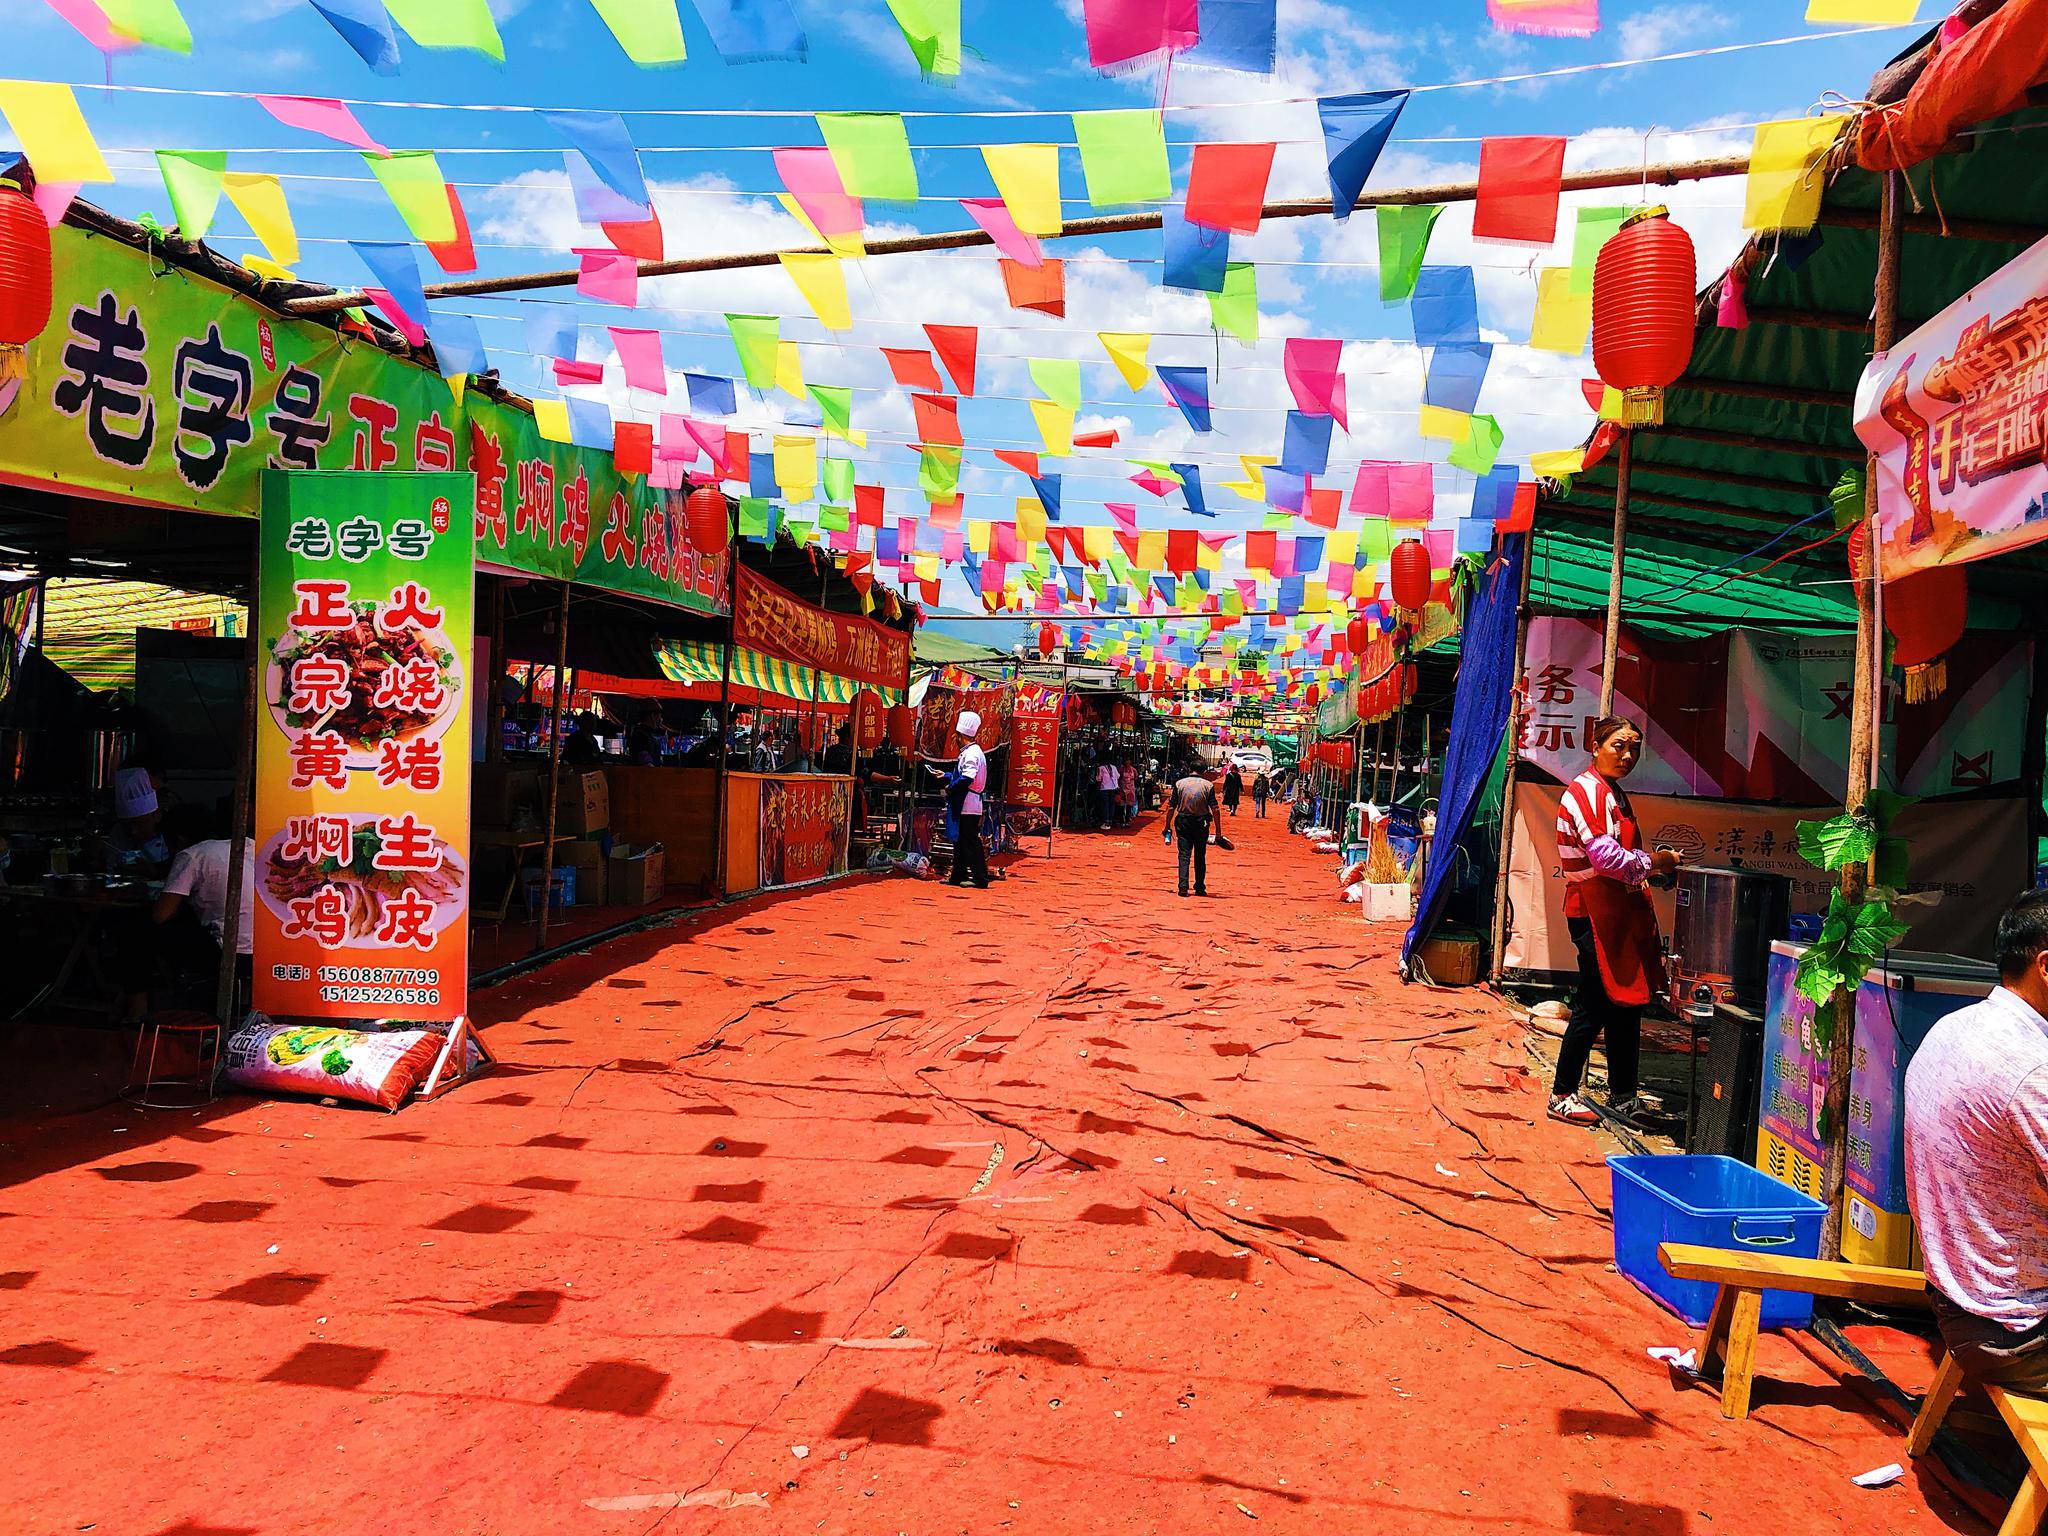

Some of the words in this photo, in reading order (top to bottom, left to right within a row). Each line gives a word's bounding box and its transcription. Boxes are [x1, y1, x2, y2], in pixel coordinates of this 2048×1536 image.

[260, 324, 273, 363] 杨氏
[53, 289, 332, 491] 老字号
[434, 502, 447, 529] 杨氏
[287, 517, 432, 562] 老字号
[864, 703, 876, 738] 小郎酒
[1017, 721, 1053, 733] 老字号
[281, 579, 355, 948] 正宗黄焖鸡
[374, 579, 446, 951] 火烧猪生皮
[1015, 734, 1049, 804] 永平黄焖鸡
[1741, 860, 1775, 869] ANGBI
[317, 966, 440, 985] 15608877799
[318, 986, 441, 1005] 15125226586
